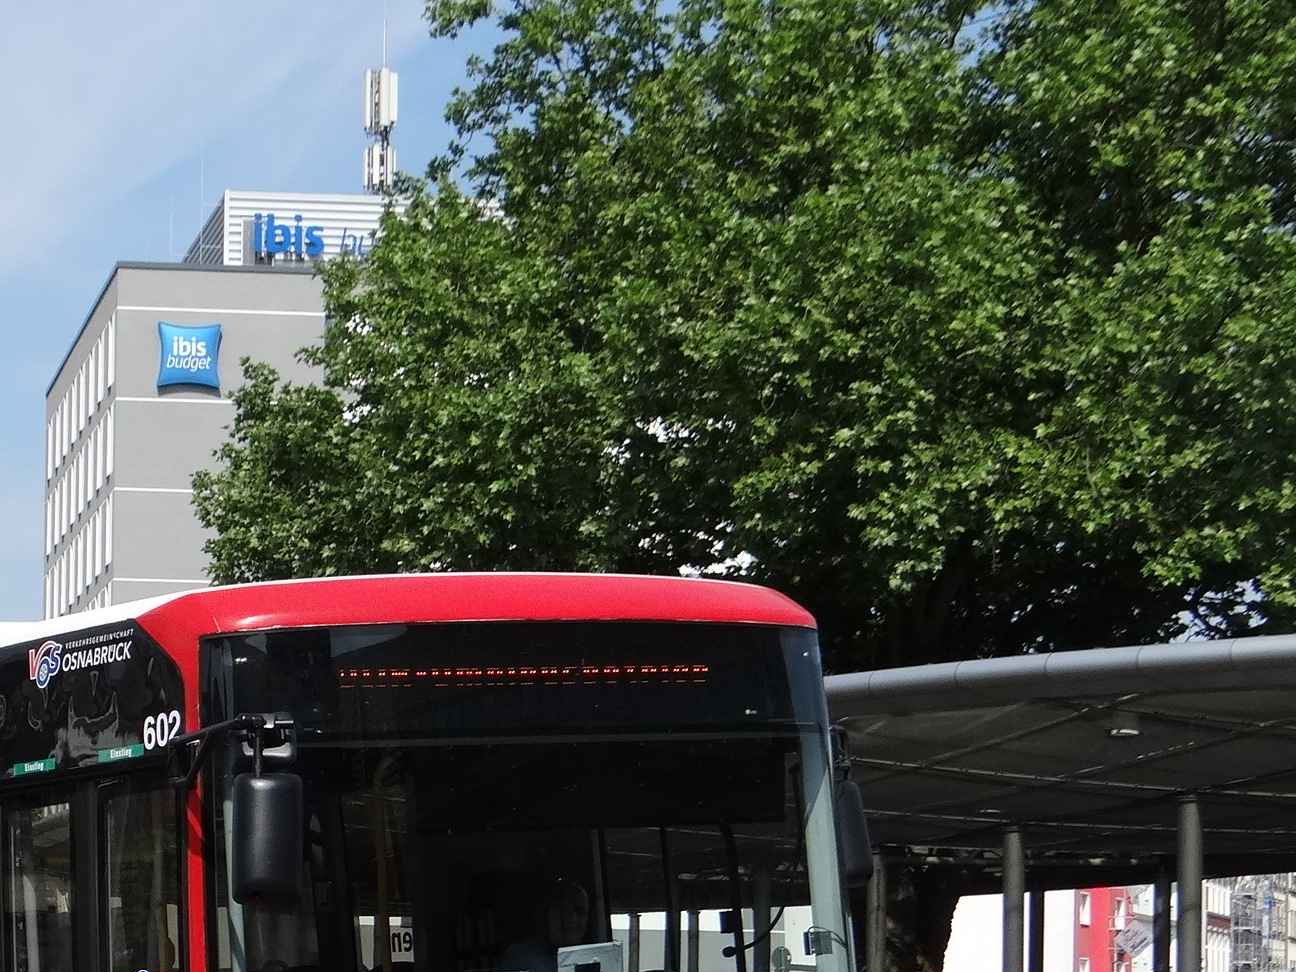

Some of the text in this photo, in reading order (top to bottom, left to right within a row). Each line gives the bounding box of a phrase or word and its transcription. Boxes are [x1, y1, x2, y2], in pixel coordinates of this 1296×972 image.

[254, 213, 324, 257] ibis
[172, 336, 207, 357] ibis
[166, 354, 212, 373] budget
[62, 641, 132, 672] OSNABRÜCK
[143, 710, 181, 750] 602
